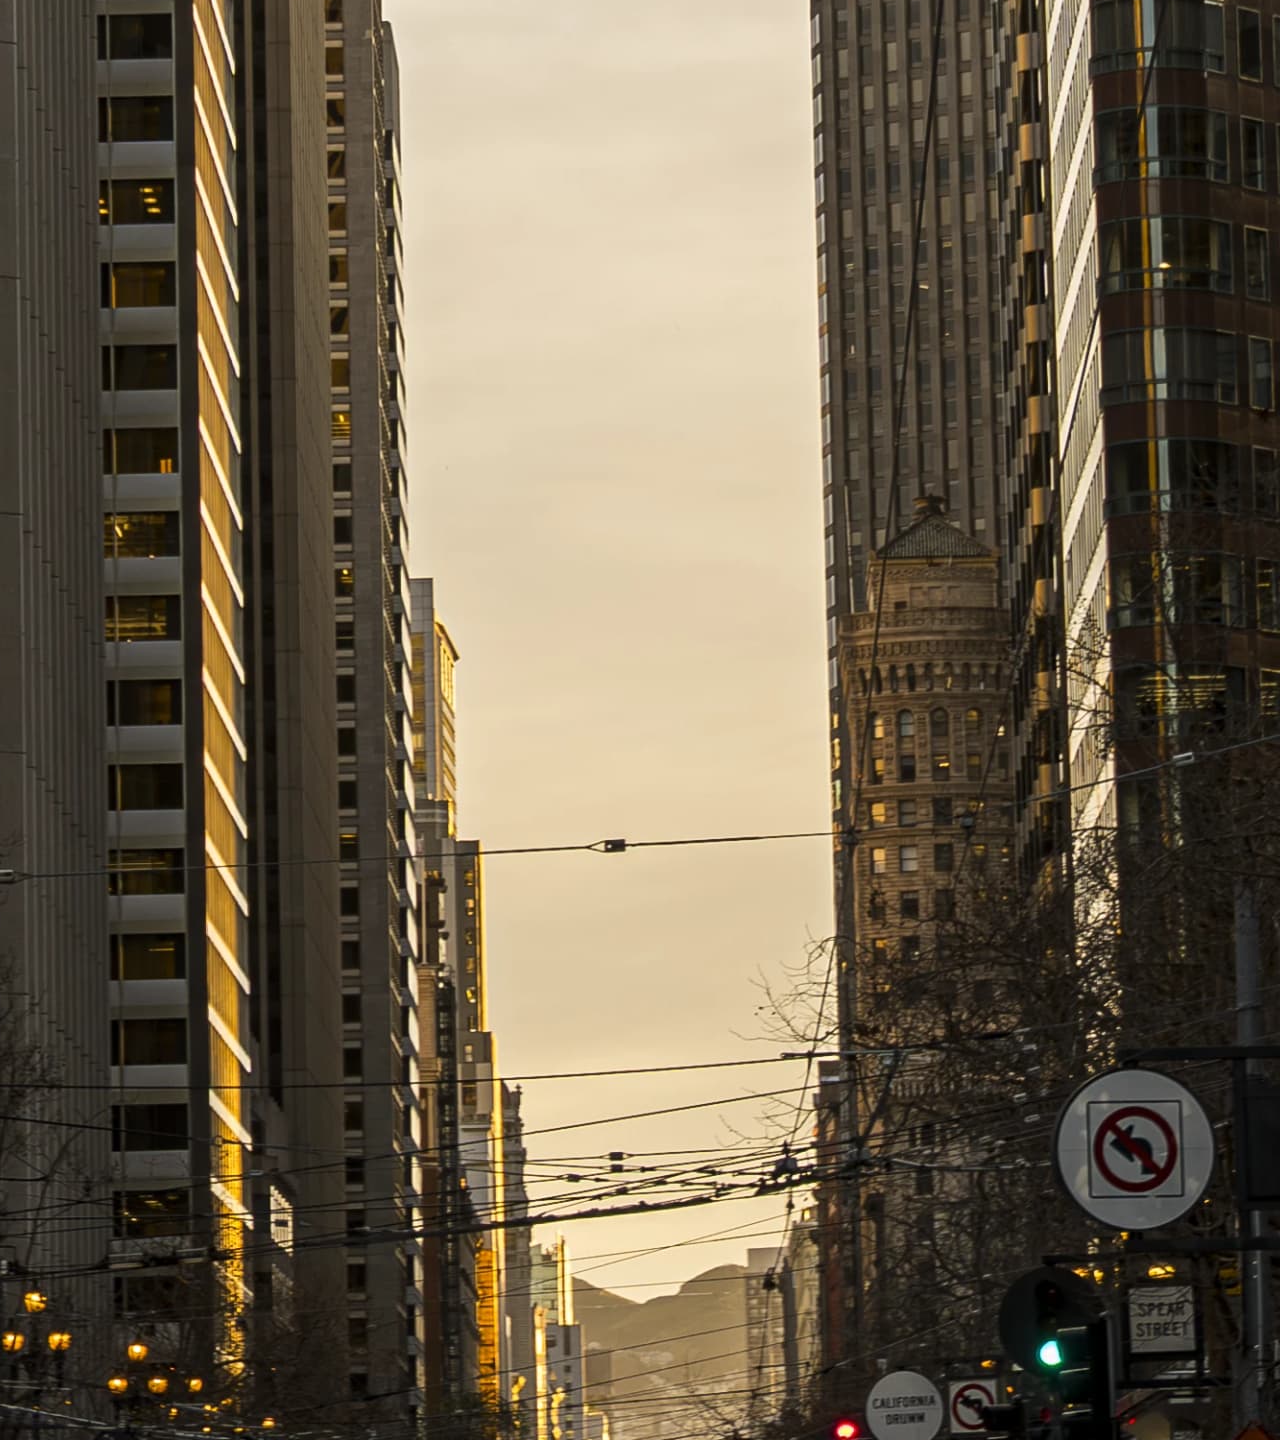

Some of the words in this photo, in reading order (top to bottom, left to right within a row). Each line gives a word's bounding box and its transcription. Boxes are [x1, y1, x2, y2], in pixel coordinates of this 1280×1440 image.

[1138, 1302, 1185, 1317] SPEAR
[1136, 1322, 1189, 1337] STREET
[872, 1395, 937, 1410] CALIFORNIA
